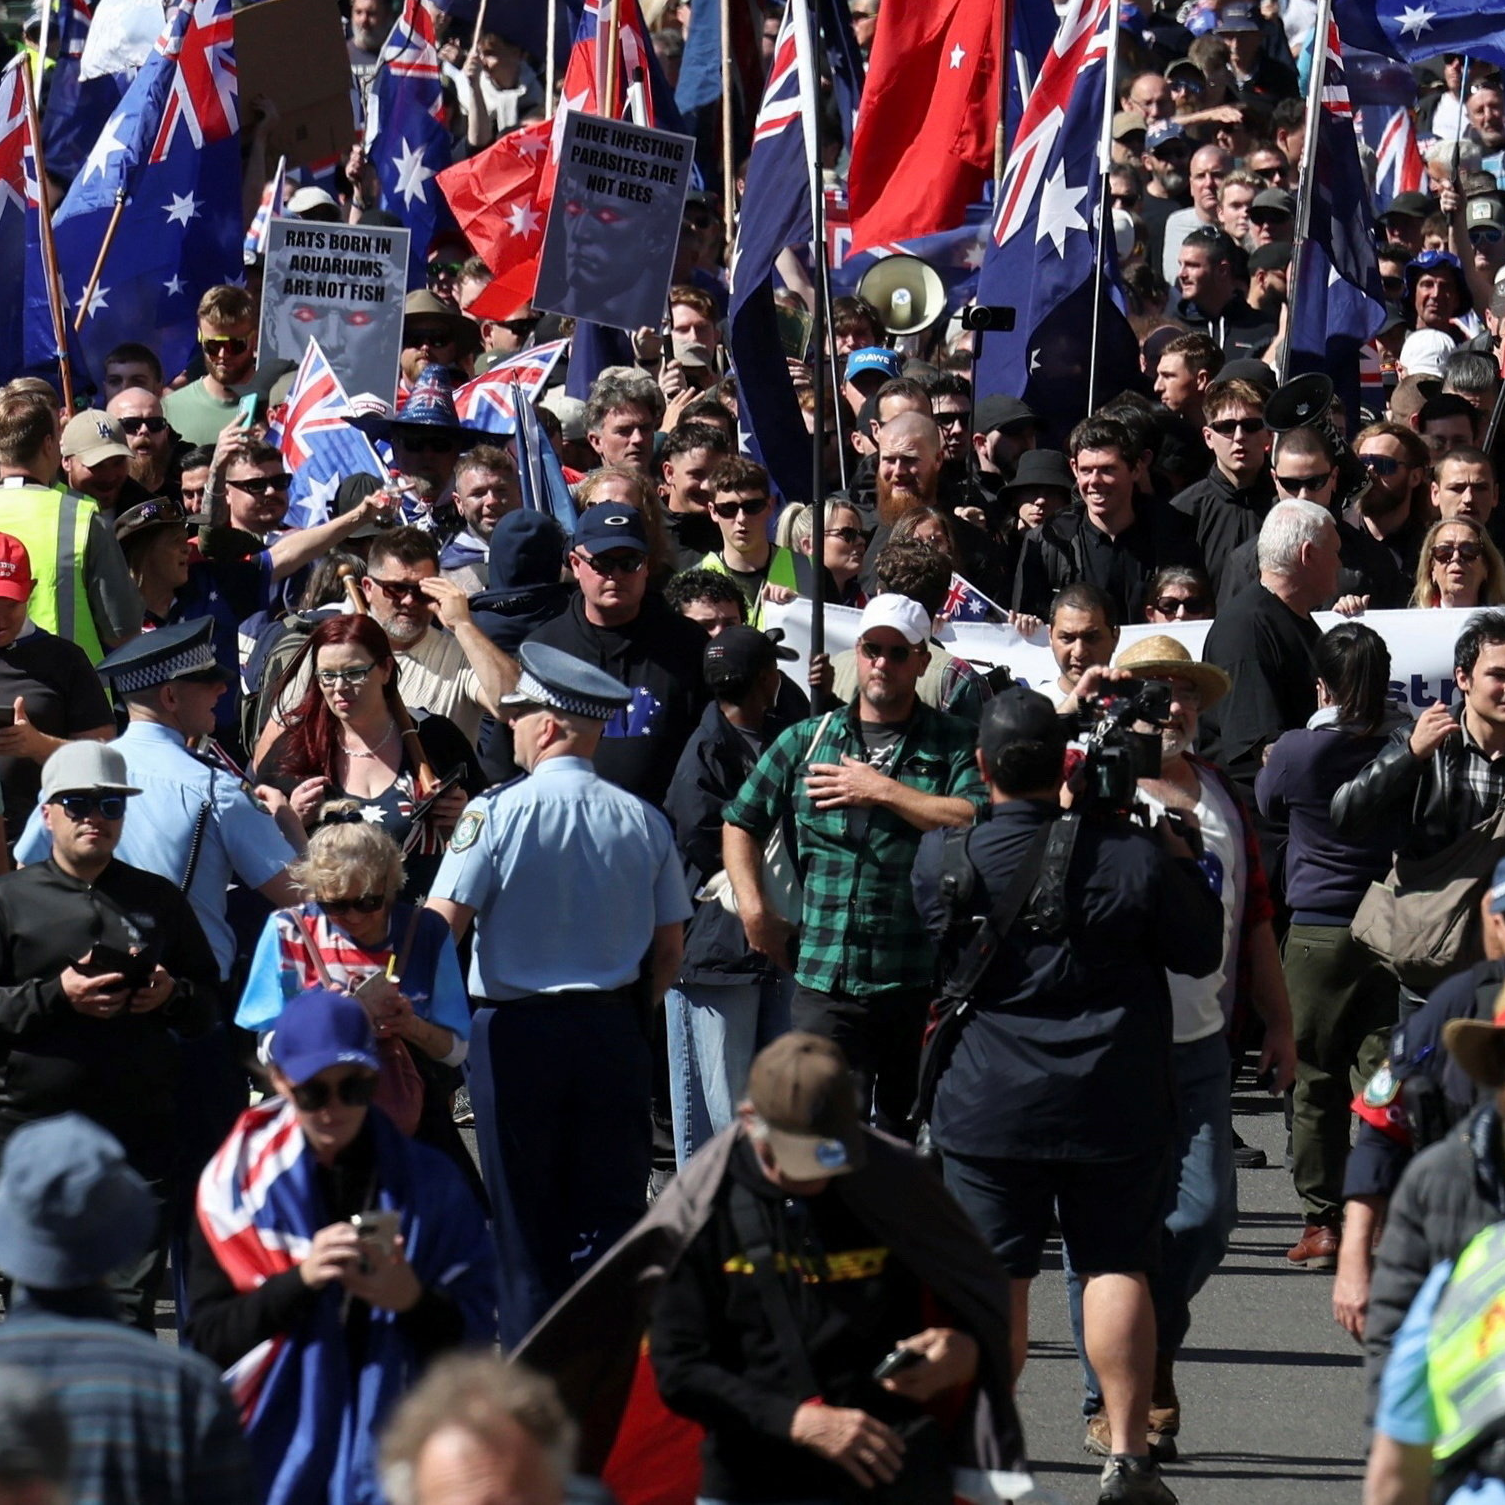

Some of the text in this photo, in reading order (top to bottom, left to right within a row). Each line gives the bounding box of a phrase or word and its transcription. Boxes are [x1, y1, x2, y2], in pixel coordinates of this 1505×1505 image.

[575, 121, 684, 162] HIVE INFESTING
[570, 145, 678, 185] PARASITES ARE
[586, 174, 653, 204] NOT BEES
[285, 230, 392, 254] RATS BORN IN
[289, 254, 383, 278] AQUARIUMS
[283, 278, 385, 302] ARE NOT FISH
[96, 421, 114, 439] LA
